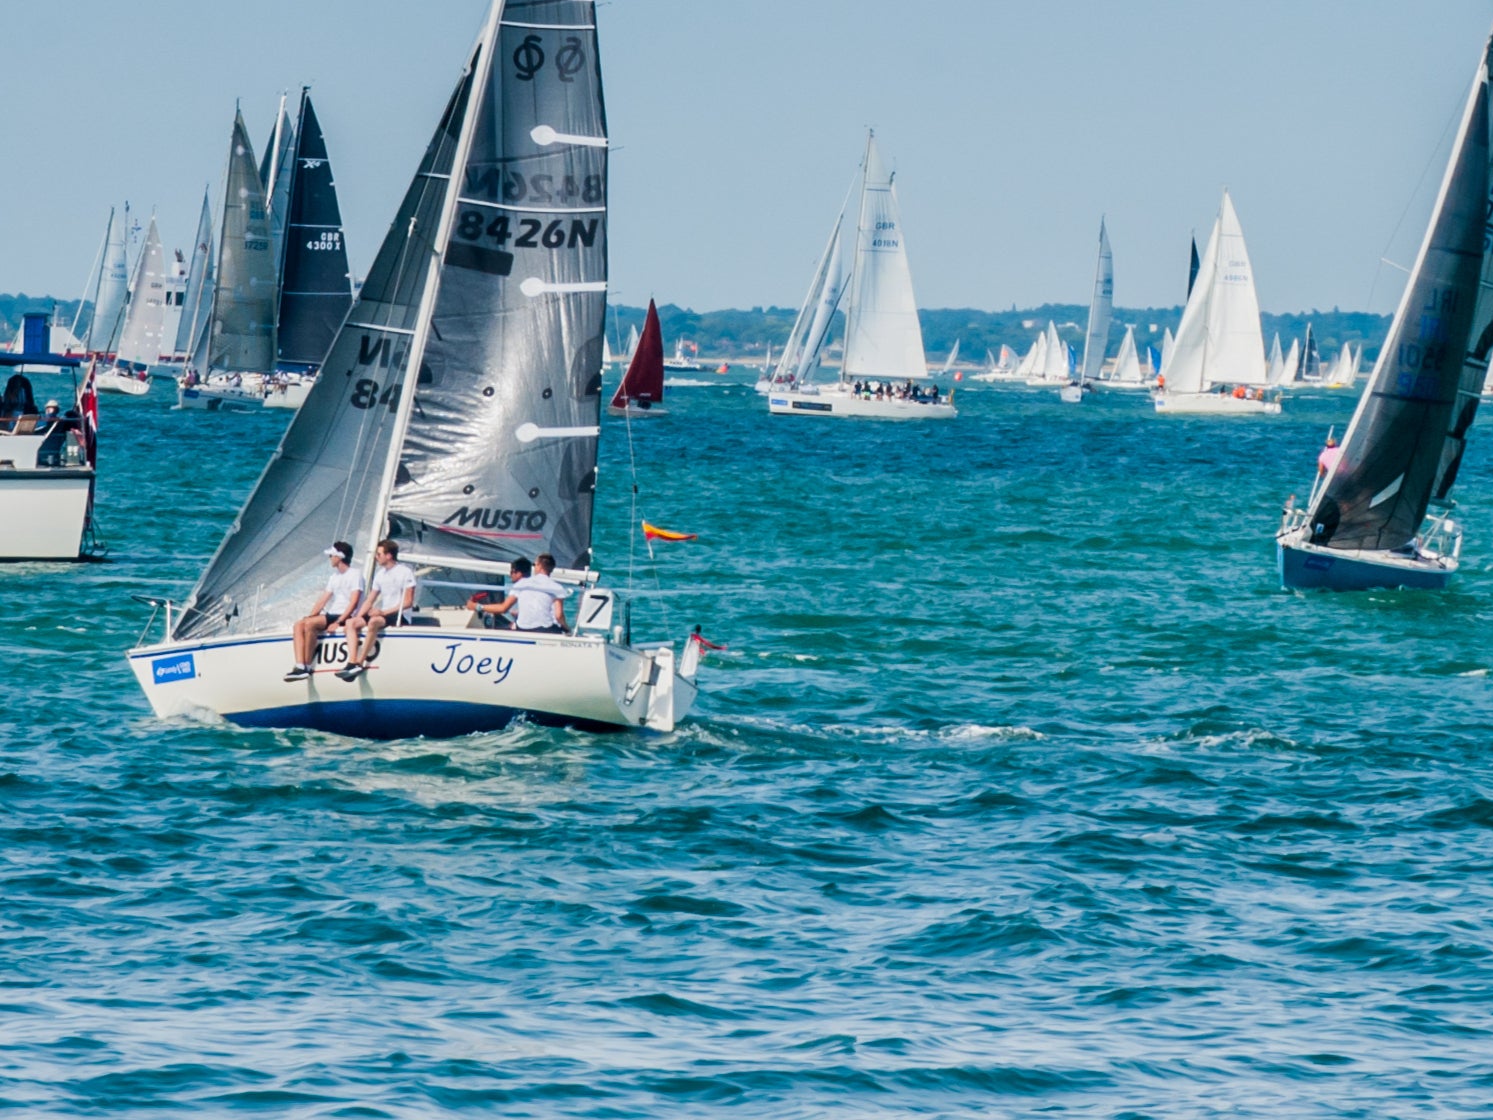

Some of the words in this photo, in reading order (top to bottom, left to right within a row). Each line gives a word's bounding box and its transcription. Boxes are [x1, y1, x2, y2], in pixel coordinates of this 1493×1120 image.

[320, 233, 340, 241] GBR
[457, 210, 599, 249] 8426N
[875, 221, 895, 230] GBR
[443, 506, 547, 531] MUSTO
[586, 594, 609, 623] 7
[430, 642, 514, 684] Joey
